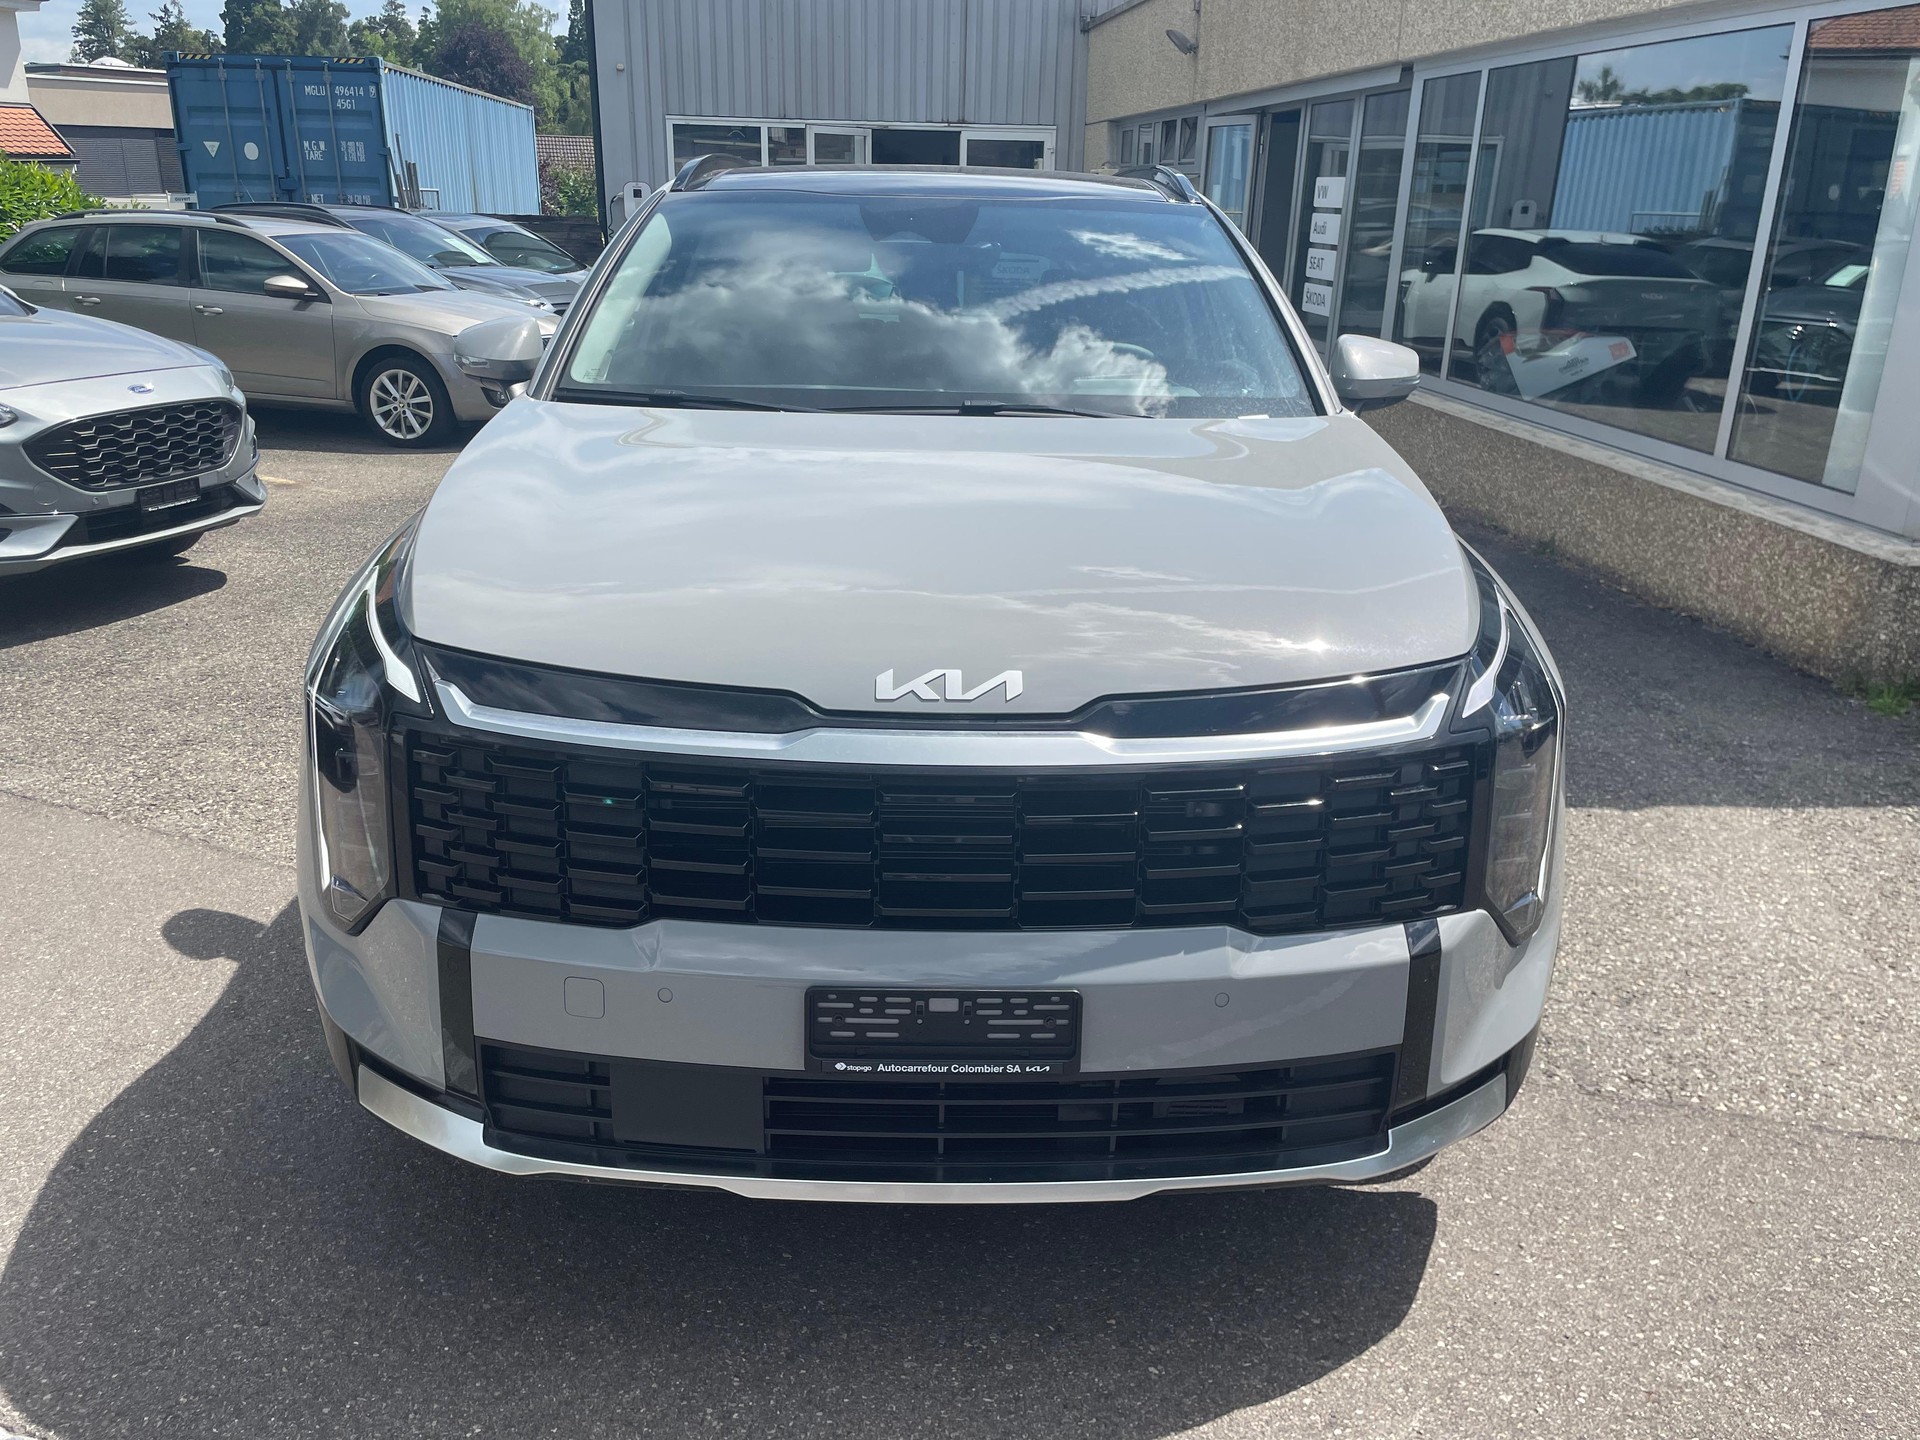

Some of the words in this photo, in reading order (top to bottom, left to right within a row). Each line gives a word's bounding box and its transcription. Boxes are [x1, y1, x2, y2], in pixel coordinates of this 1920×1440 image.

[304, 85, 326, 96] MGLU
[334, 85, 364, 97] 496414
[369, 86, 376, 98] 9
[336, 99, 356, 110] 45G1
[303, 140, 327, 151] M.G.W.
[305, 151, 324, 161] TARE
[1317, 185, 1329, 199] VW
[310, 193, 324, 204] NET
[1312, 221, 1327, 236] Audi
[1308, 256, 1325, 271] SEAT
[874, 668, 1024, 703] KIA
[877, 1063, 949, 1073] Autocarrefour
[950, 1064, 1005, 1074] Colombier
[1006, 1064, 1022, 1074] SA
